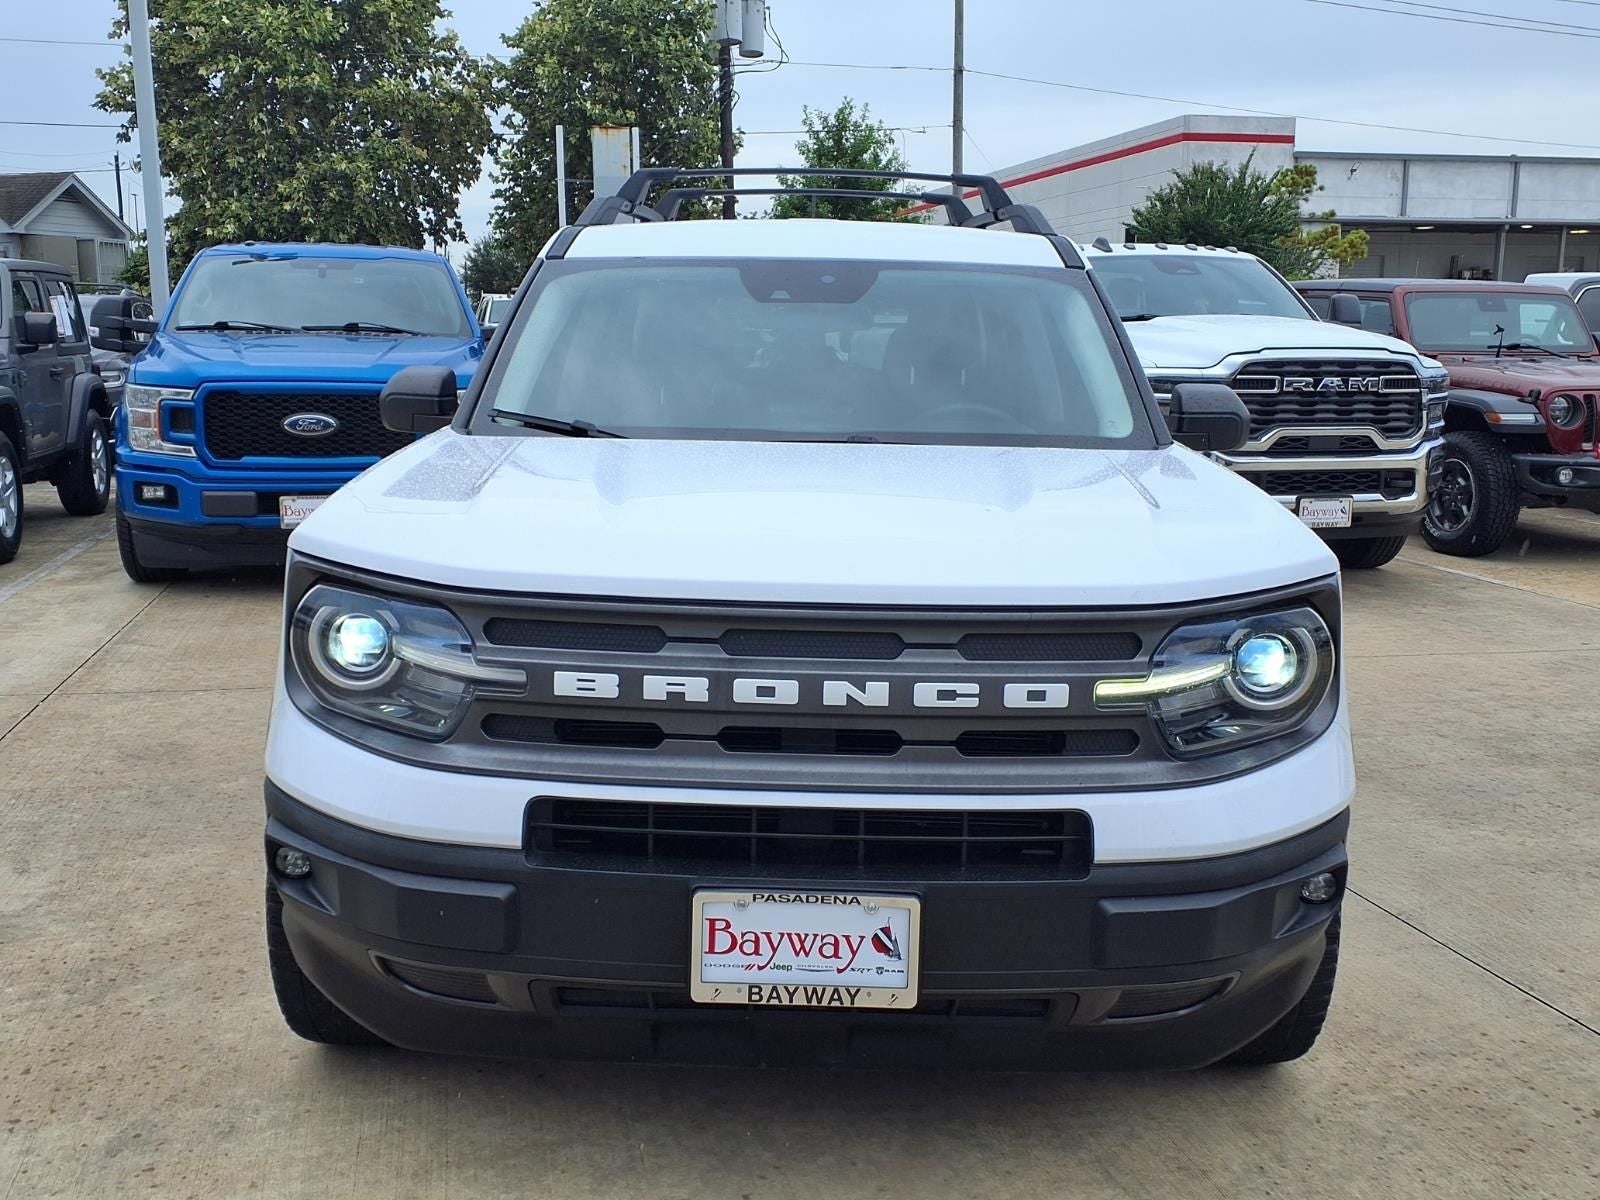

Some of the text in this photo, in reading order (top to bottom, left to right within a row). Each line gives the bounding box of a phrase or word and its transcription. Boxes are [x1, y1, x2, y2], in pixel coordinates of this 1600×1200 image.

[1282, 377, 1379, 392] RAM
[295, 418, 324, 431] Ford
[1301, 506, 1340, 519] Bayway
[553, 670, 1070, 708] BRONCO
[752, 893, 862, 906] PASADENA
[703, 917, 866, 975] Bayway
[769, 962, 793, 972] Jeep
[748, 985, 862, 1006] BAYWAY
